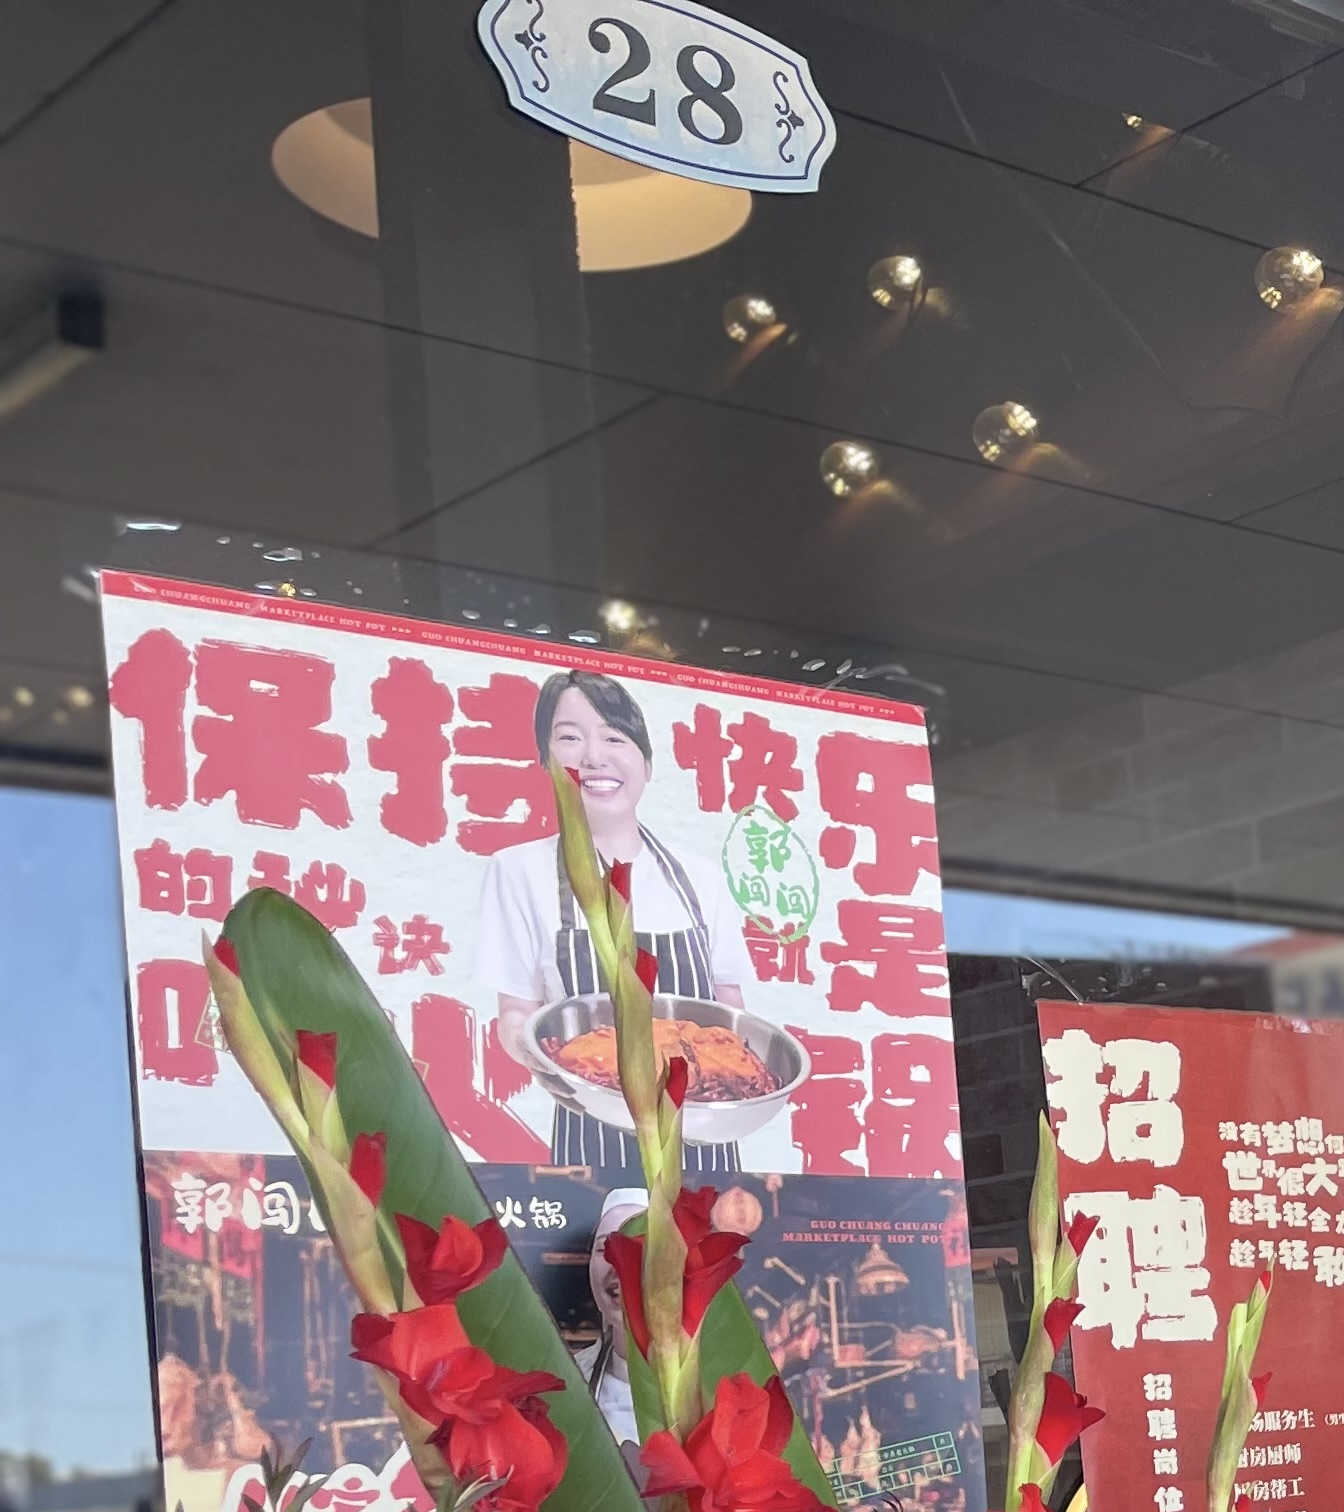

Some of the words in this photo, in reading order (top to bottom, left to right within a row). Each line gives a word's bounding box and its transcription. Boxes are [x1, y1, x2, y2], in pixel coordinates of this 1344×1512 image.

[589, 18, 742, 145] 28
[171, 1173, 325, 1235] 郭闯
[1042, 1029, 1218, 1350] 招聘
[782, 1232, 881, 1243] MARKETPLACE
[887, 1234, 914, 1244] HOT
[810, 1220, 837, 1230] GUO
[839, 1221, 892, 1231] CHUANG
